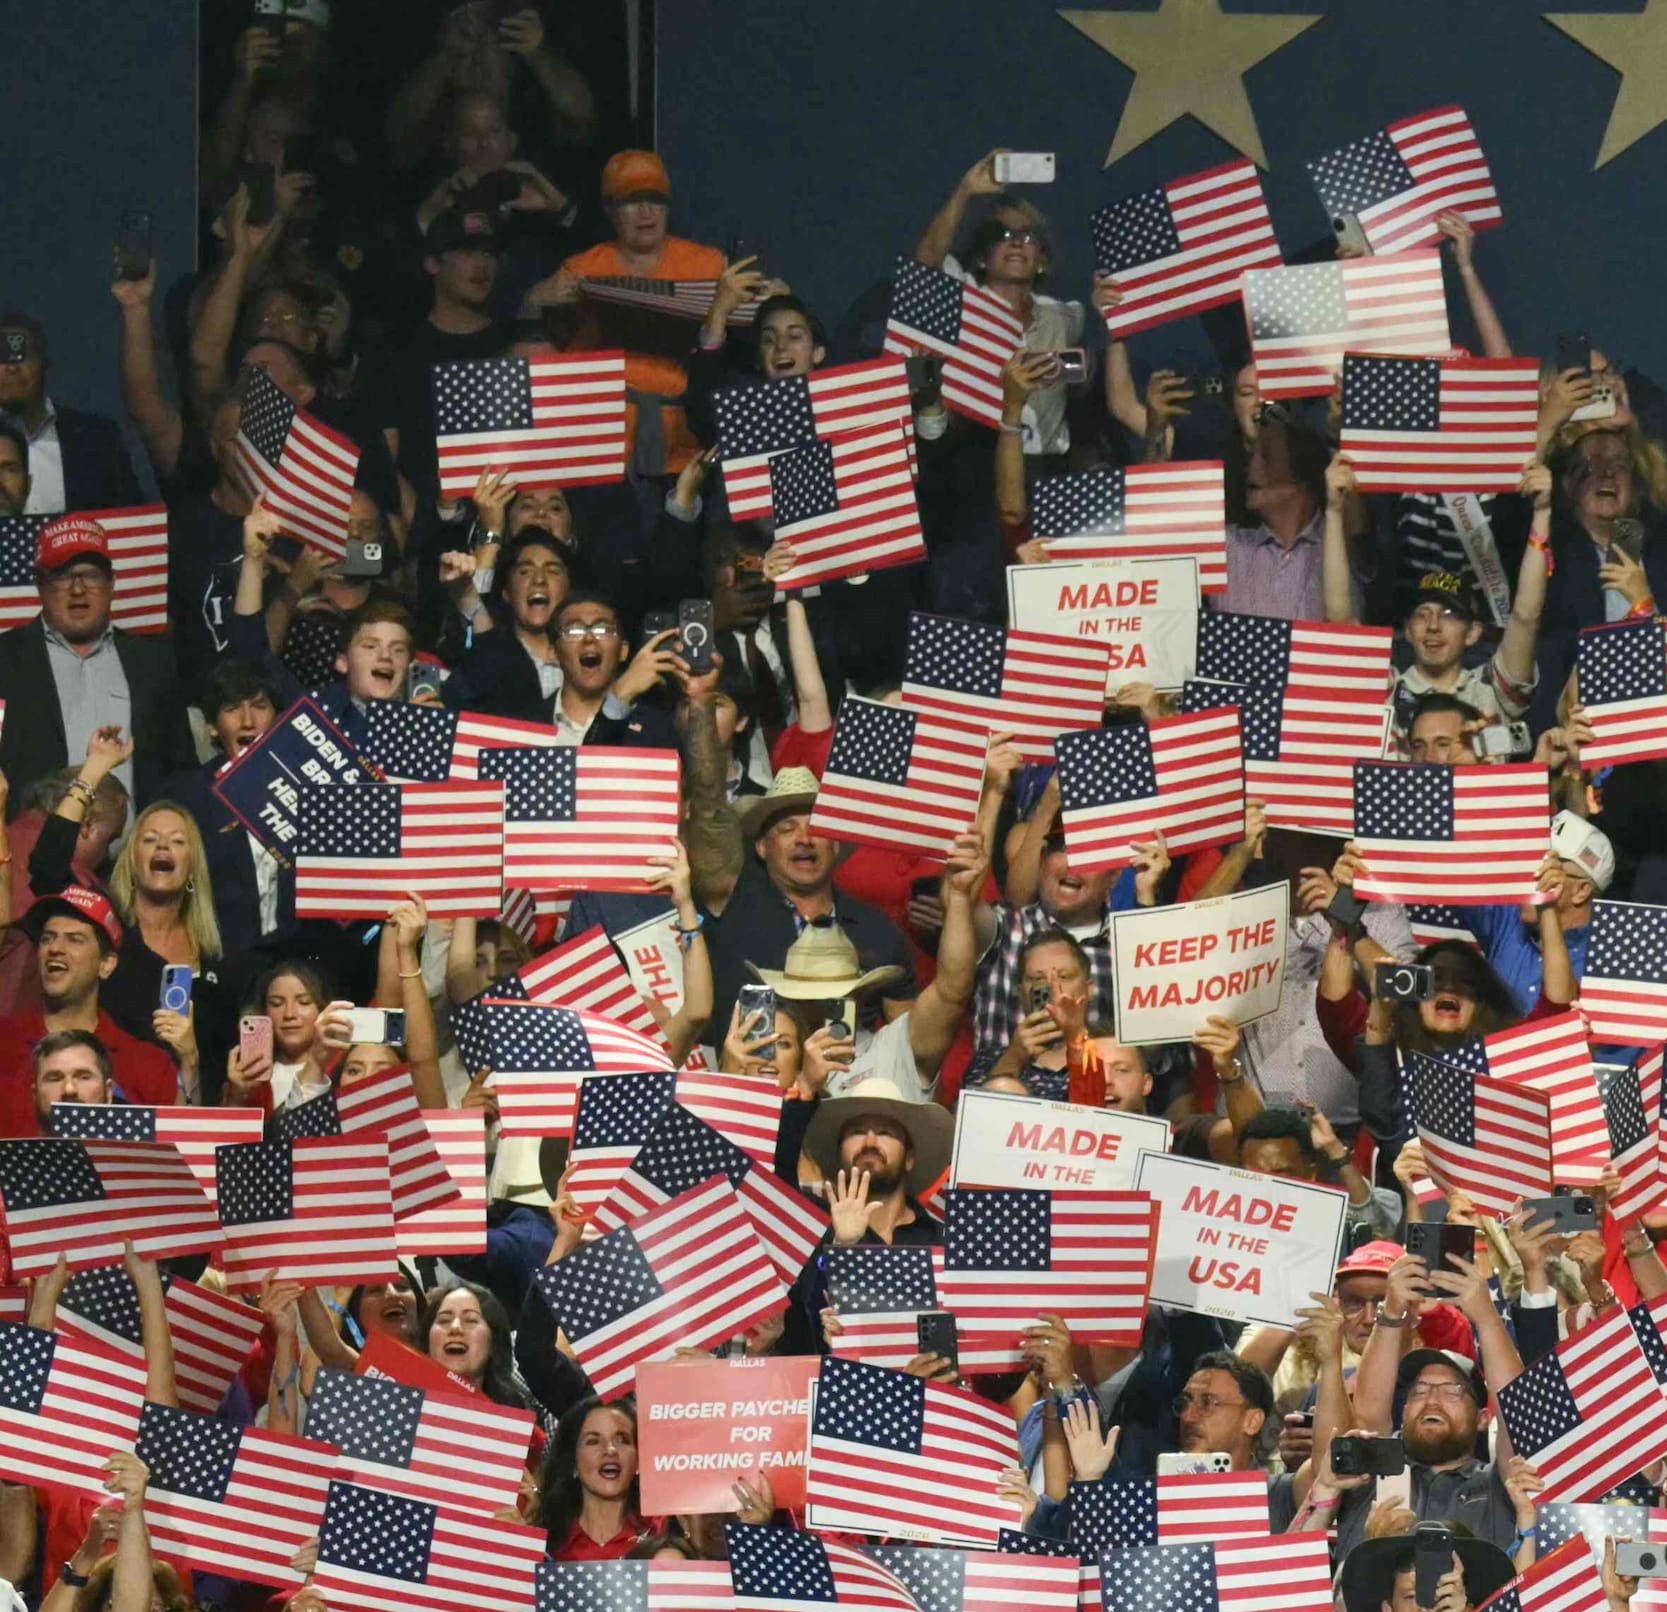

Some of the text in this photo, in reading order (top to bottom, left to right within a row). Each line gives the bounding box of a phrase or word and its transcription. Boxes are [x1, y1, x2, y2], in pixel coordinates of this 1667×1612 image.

[1058, 579, 1159, 611] MADE
[1079, 617, 1142, 635] IN THE
[1107, 643, 1148, 669] SA
[291, 712, 361, 785] BIDEN &
[258, 803, 301, 842] THE
[1133, 918, 1276, 969] KEEP THE
[633, 943, 680, 1009] THE
[1127, 957, 1280, 1011] MAJORITY
[1005, 1120, 1122, 1162] MADE
[1023, 1161, 1096, 1186] IN THE
[1181, 1185, 1298, 1233] MADE
[1195, 1226, 1270, 1256] IN THE
[1187, 1256, 1263, 1297] USA
[730, 1358, 767, 1368] DALLAS
[447, 1370, 476, 1393] DALLAS
[650, 1399, 809, 1421] BIGGER PAYCHE
[730, 1426, 773, 1443] FOR
[655, 1450, 809, 1471] WORKING FAMI
